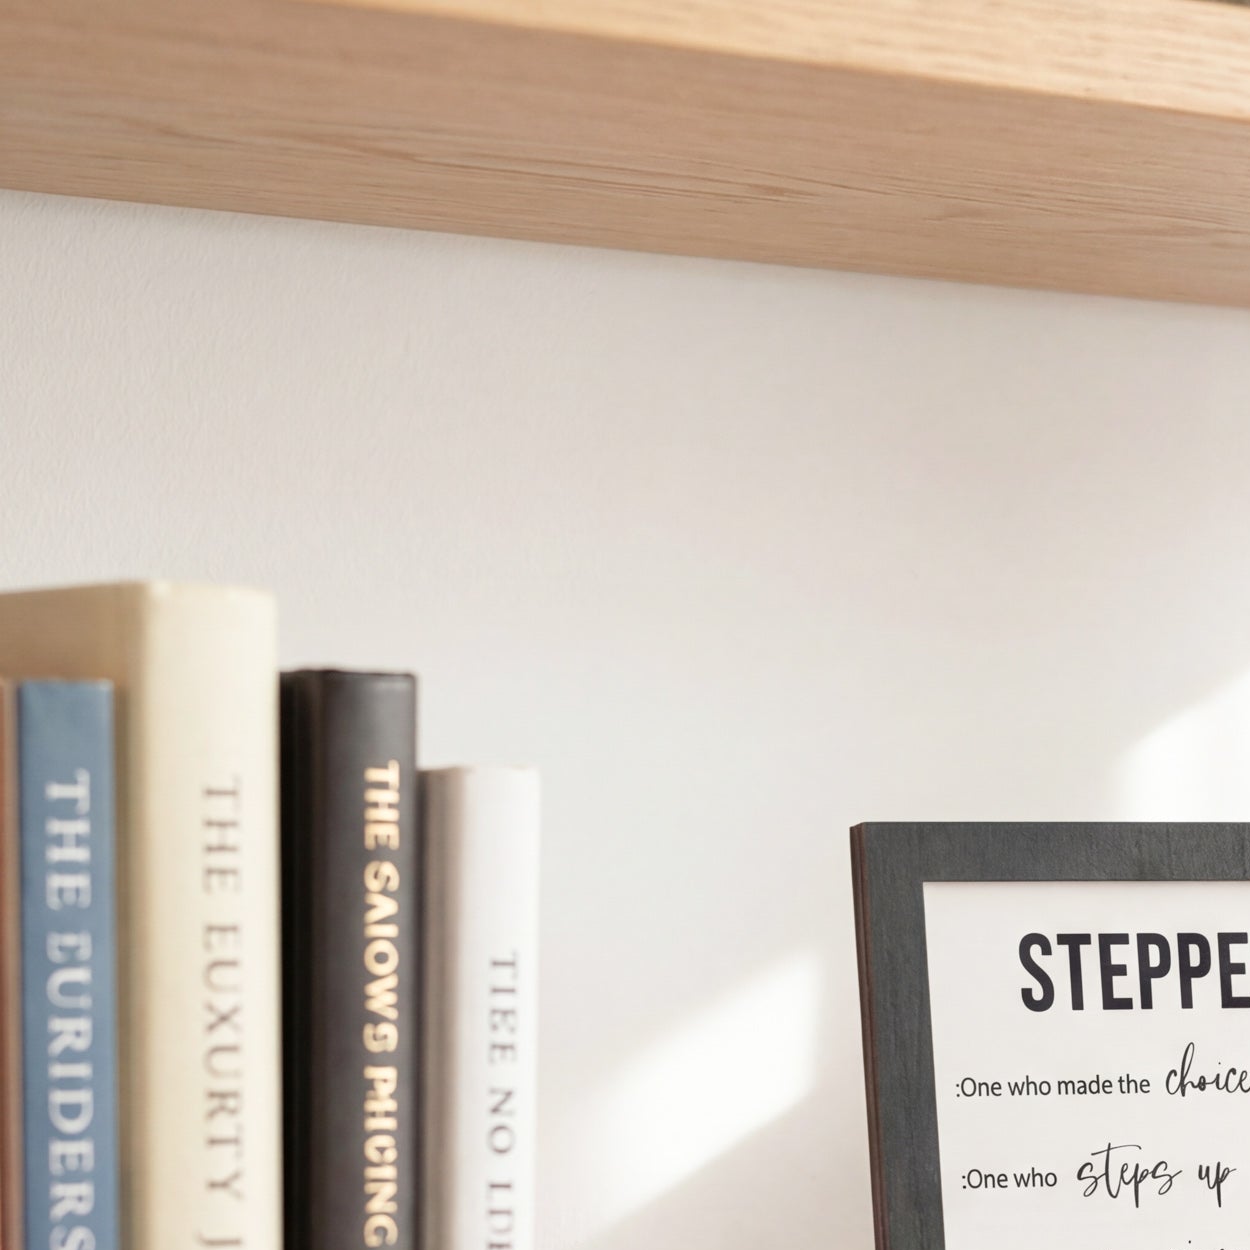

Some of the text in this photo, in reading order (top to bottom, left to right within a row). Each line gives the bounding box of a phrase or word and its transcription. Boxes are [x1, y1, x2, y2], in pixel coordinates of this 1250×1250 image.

[44, 767, 92, 911] THE
[202, 776, 244, 891] THE
[363, 759, 401, 850] THE
[486, 1087, 518, 1156] NO
[1007, 1074, 1052, 1097] who
[1057, 1074, 1113, 1096] made
[1117, 1073, 1151, 1095] the
[1013, 1166, 1058, 1188] who
[1076, 1142, 1183, 1209] steps
[1197, 1161, 1237, 1208] up
